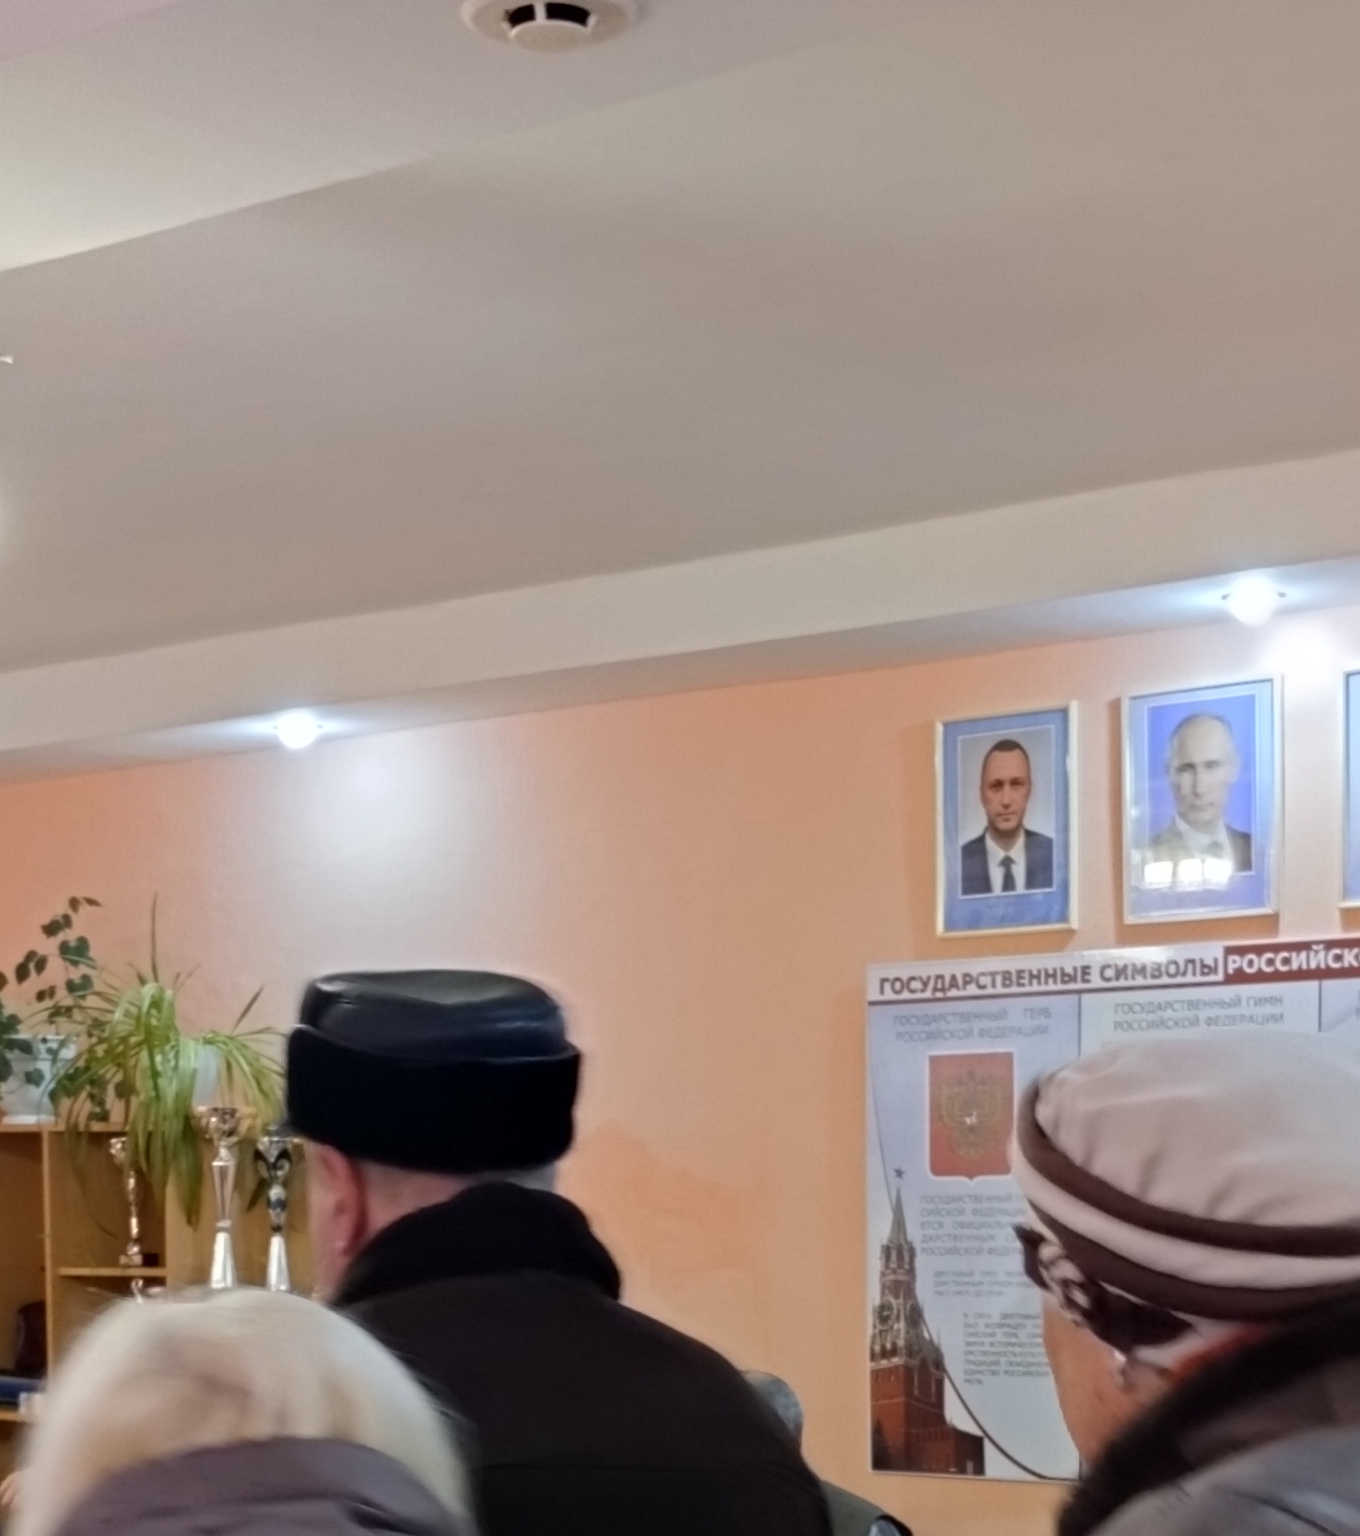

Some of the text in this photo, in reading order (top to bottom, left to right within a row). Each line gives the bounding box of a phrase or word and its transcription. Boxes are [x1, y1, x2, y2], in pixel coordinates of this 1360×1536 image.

[879, 964, 1092, 997] ГОСУДАРСТВЕННЫЕ
[1099, 956, 1218, 983] СИМВОЛЫ
[1114, 994, 1284, 1015] ГОСУДАРСТВЕННЫЙ ГИМН
[893, 1007, 1052, 1027] ГОСУДАРСТВЕННЫЙ ГЕРБ
[1113, 1013, 1284, 1032] РОССИЙСКОЙ ФЕДЕРАЦИИ
[895, 1024, 1049, 1042] РОССИЙСКОЙ ФЕДЕРАЦИИ
